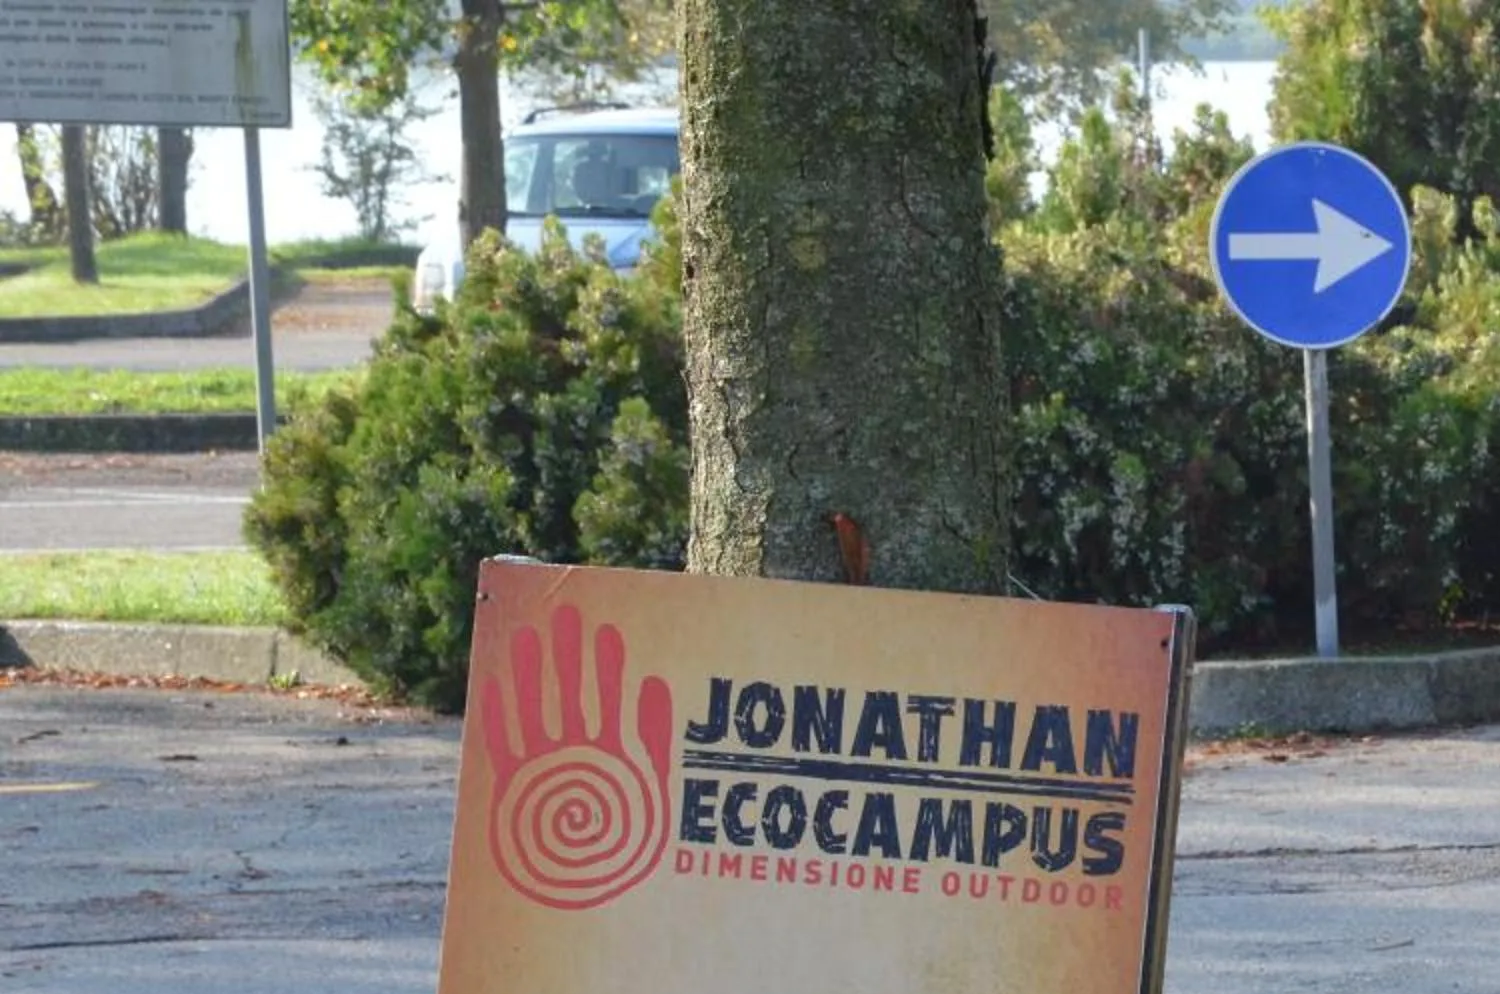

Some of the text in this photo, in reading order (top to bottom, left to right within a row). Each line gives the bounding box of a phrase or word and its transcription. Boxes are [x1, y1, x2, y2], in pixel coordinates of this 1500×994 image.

[685, 677, 1139, 778] JONATHAN
[680, 778, 1126, 875] ECOCAMPUS
[674, 849, 1123, 909] DIMENSIONE OUTDOOR
